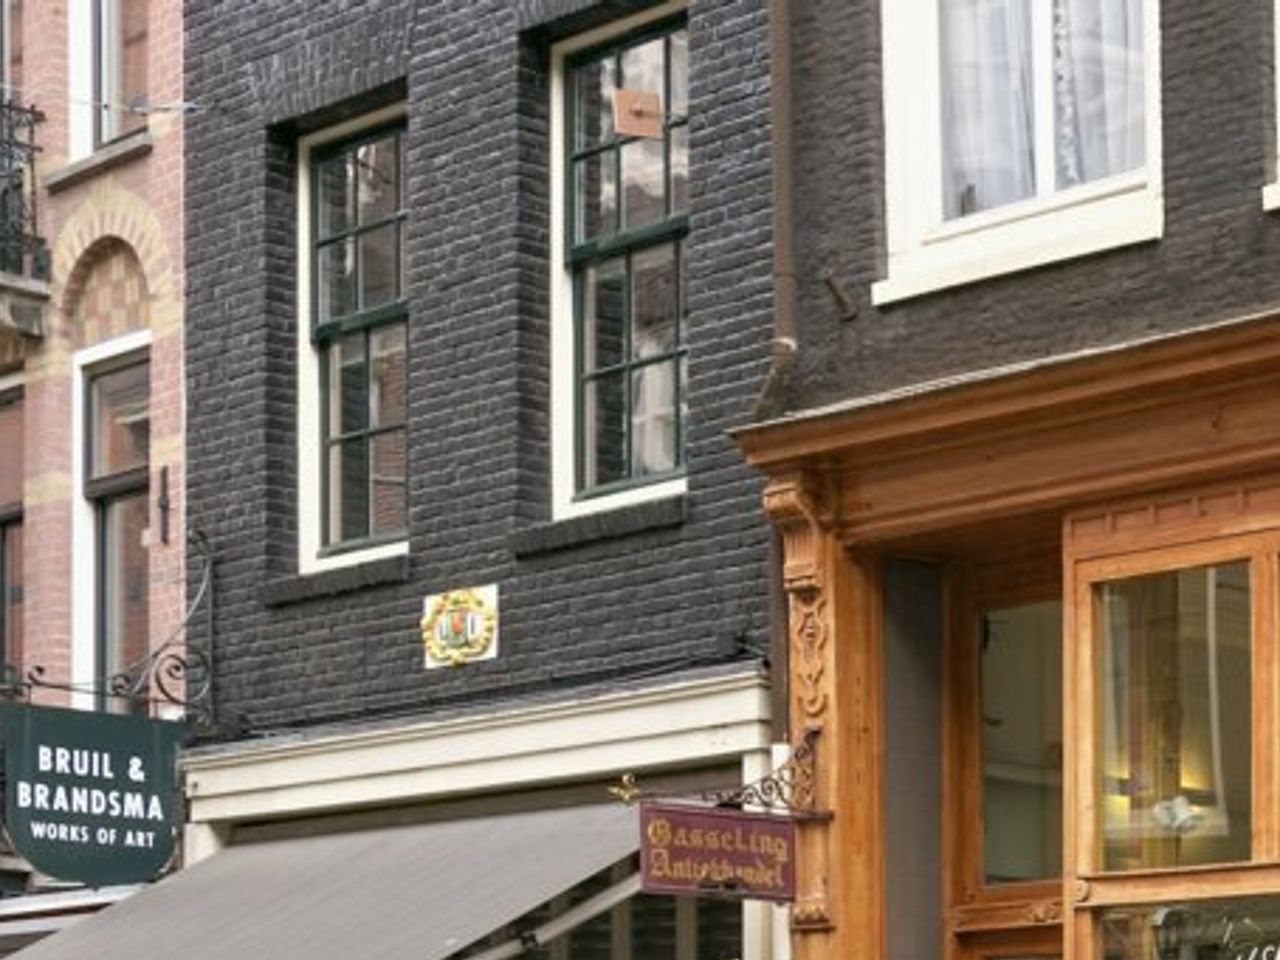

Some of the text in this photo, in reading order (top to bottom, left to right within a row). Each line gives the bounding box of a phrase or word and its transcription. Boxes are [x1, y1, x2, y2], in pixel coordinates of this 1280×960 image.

[39, 744, 145, 782] BRUIL &
[17, 781, 163, 821] BRANDSMA
[31, 820, 155, 848] WORKS OF ART
[647, 818, 788, 861] Gasseling
